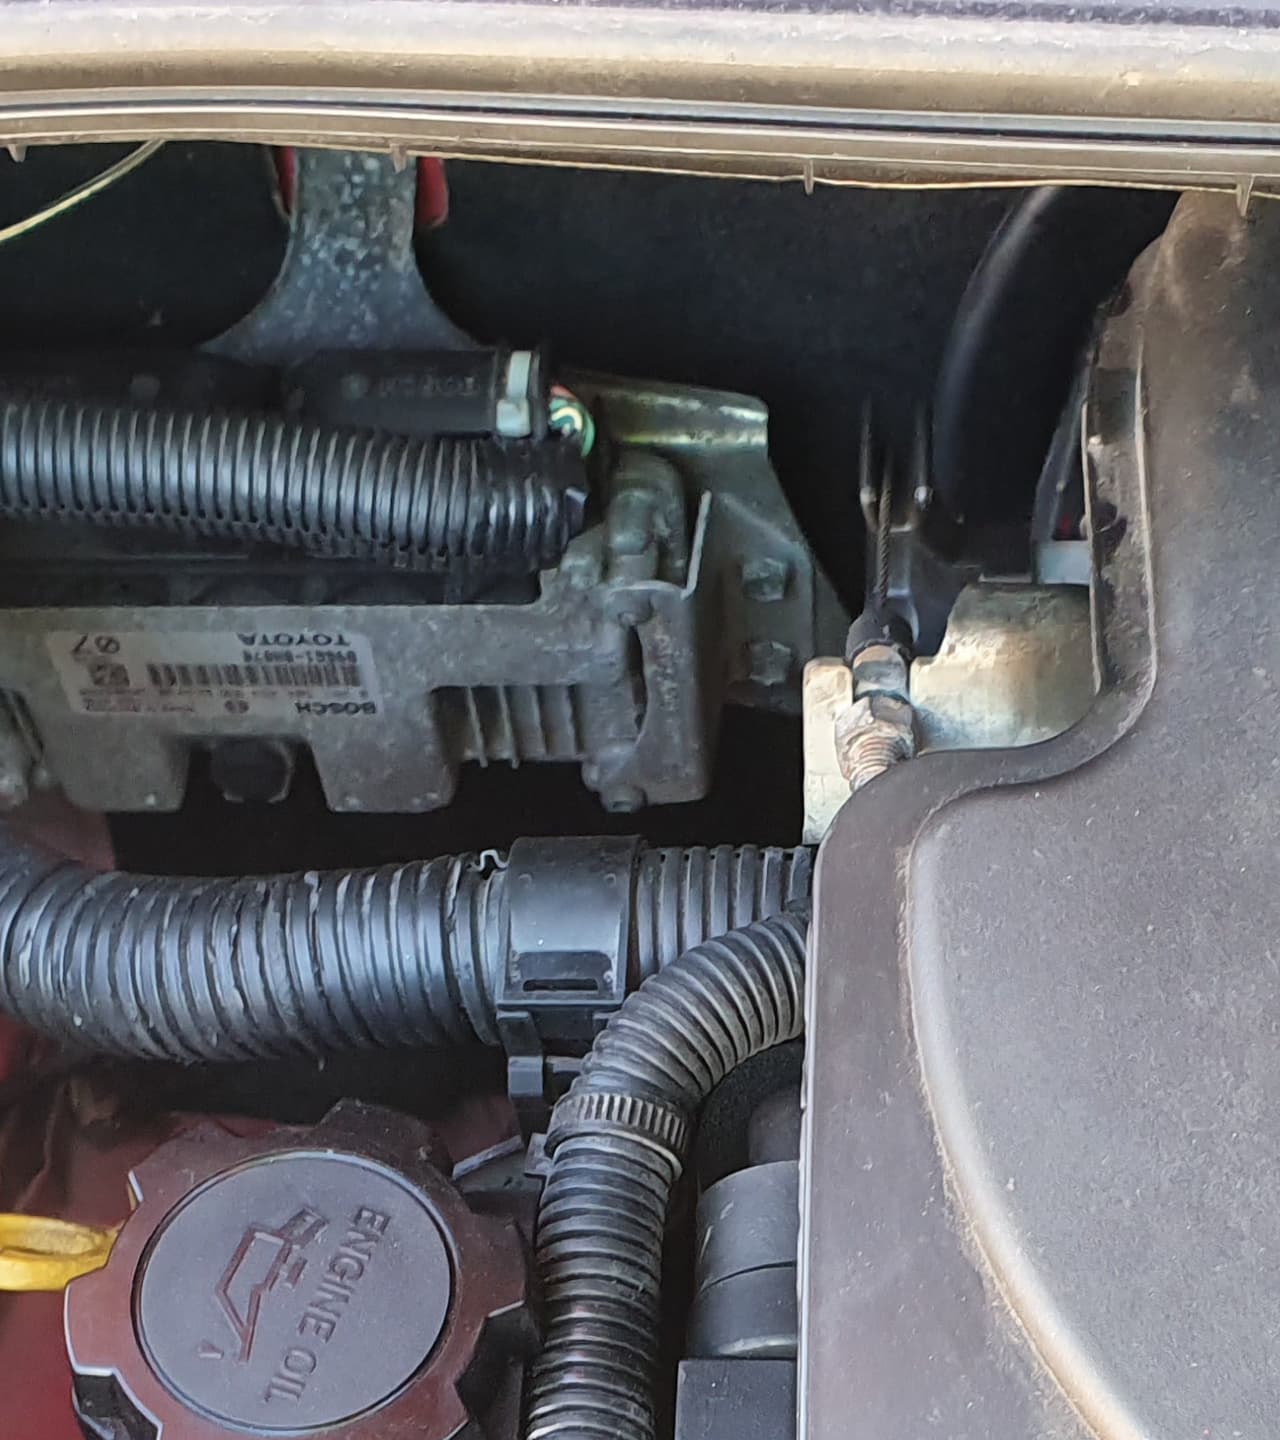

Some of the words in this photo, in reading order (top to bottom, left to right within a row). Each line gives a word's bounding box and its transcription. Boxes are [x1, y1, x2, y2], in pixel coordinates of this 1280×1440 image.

[236, 632, 351, 646] TOYOTA
[296, 701, 377, 715] BOSCH
[297, 1205, 392, 1343] ENGINE
[258, 1343, 317, 1404] OIL
